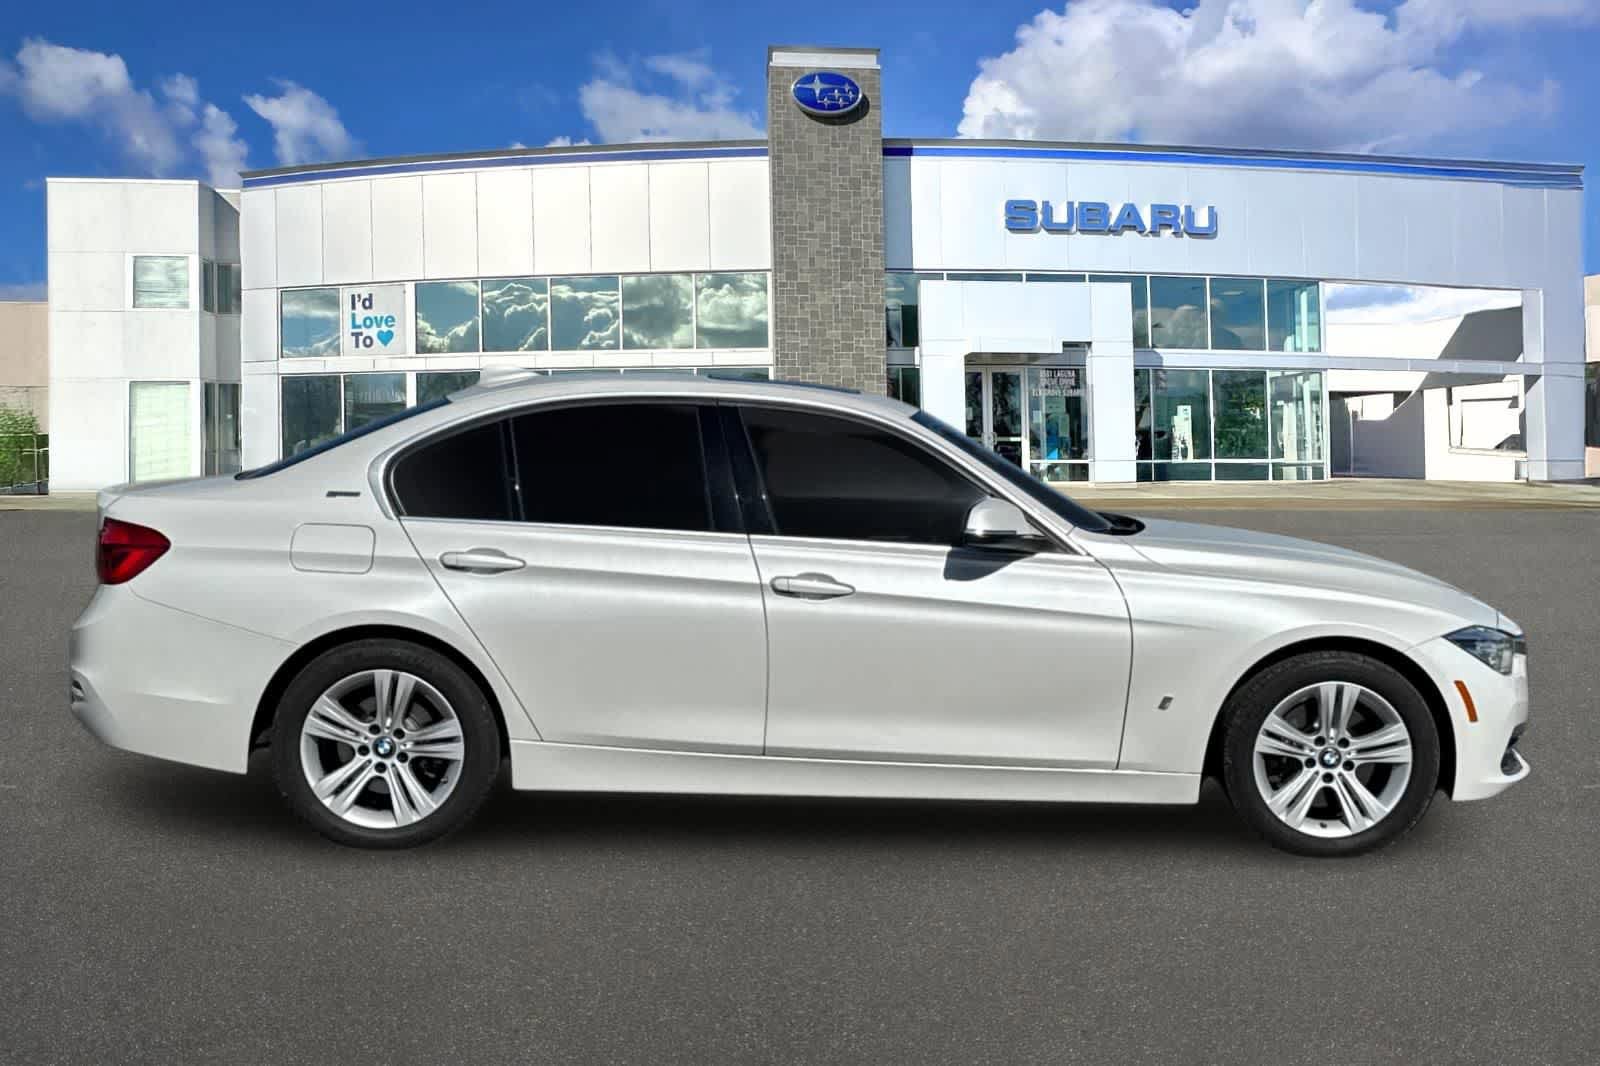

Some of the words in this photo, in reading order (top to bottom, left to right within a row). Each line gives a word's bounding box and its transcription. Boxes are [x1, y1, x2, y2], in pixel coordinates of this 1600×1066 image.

[1005, 199, 1216, 238] SUBARU
[351, 293, 373, 311] I'd
[351, 312, 396, 329] Love
[351, 331, 374, 349] To
